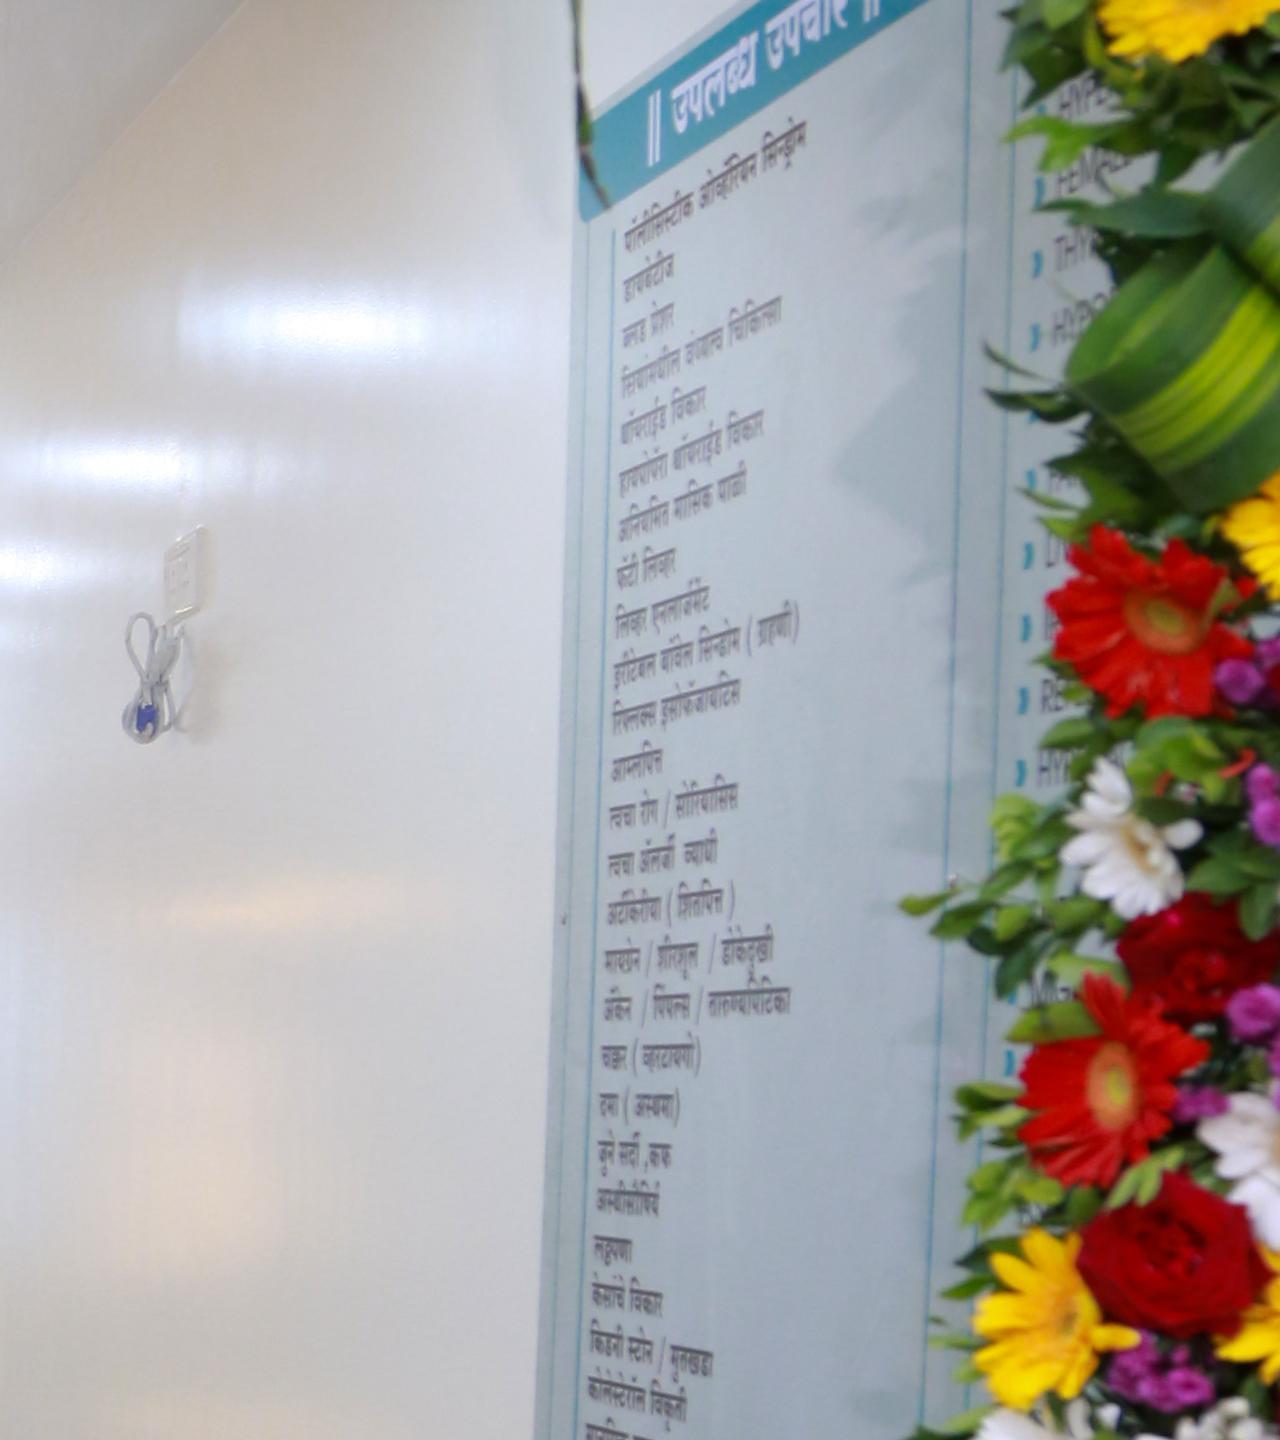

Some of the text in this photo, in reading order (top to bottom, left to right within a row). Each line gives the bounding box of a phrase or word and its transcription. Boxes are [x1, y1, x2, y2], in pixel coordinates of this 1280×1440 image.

[671, 31, 759, 135] उपलब्ध
[670, 385, 706, 423] विकार
[725, 409, 763, 448] विकार
[639, 789, 658, 824] रोग
[629, 1276, 663, 1316] विकार
